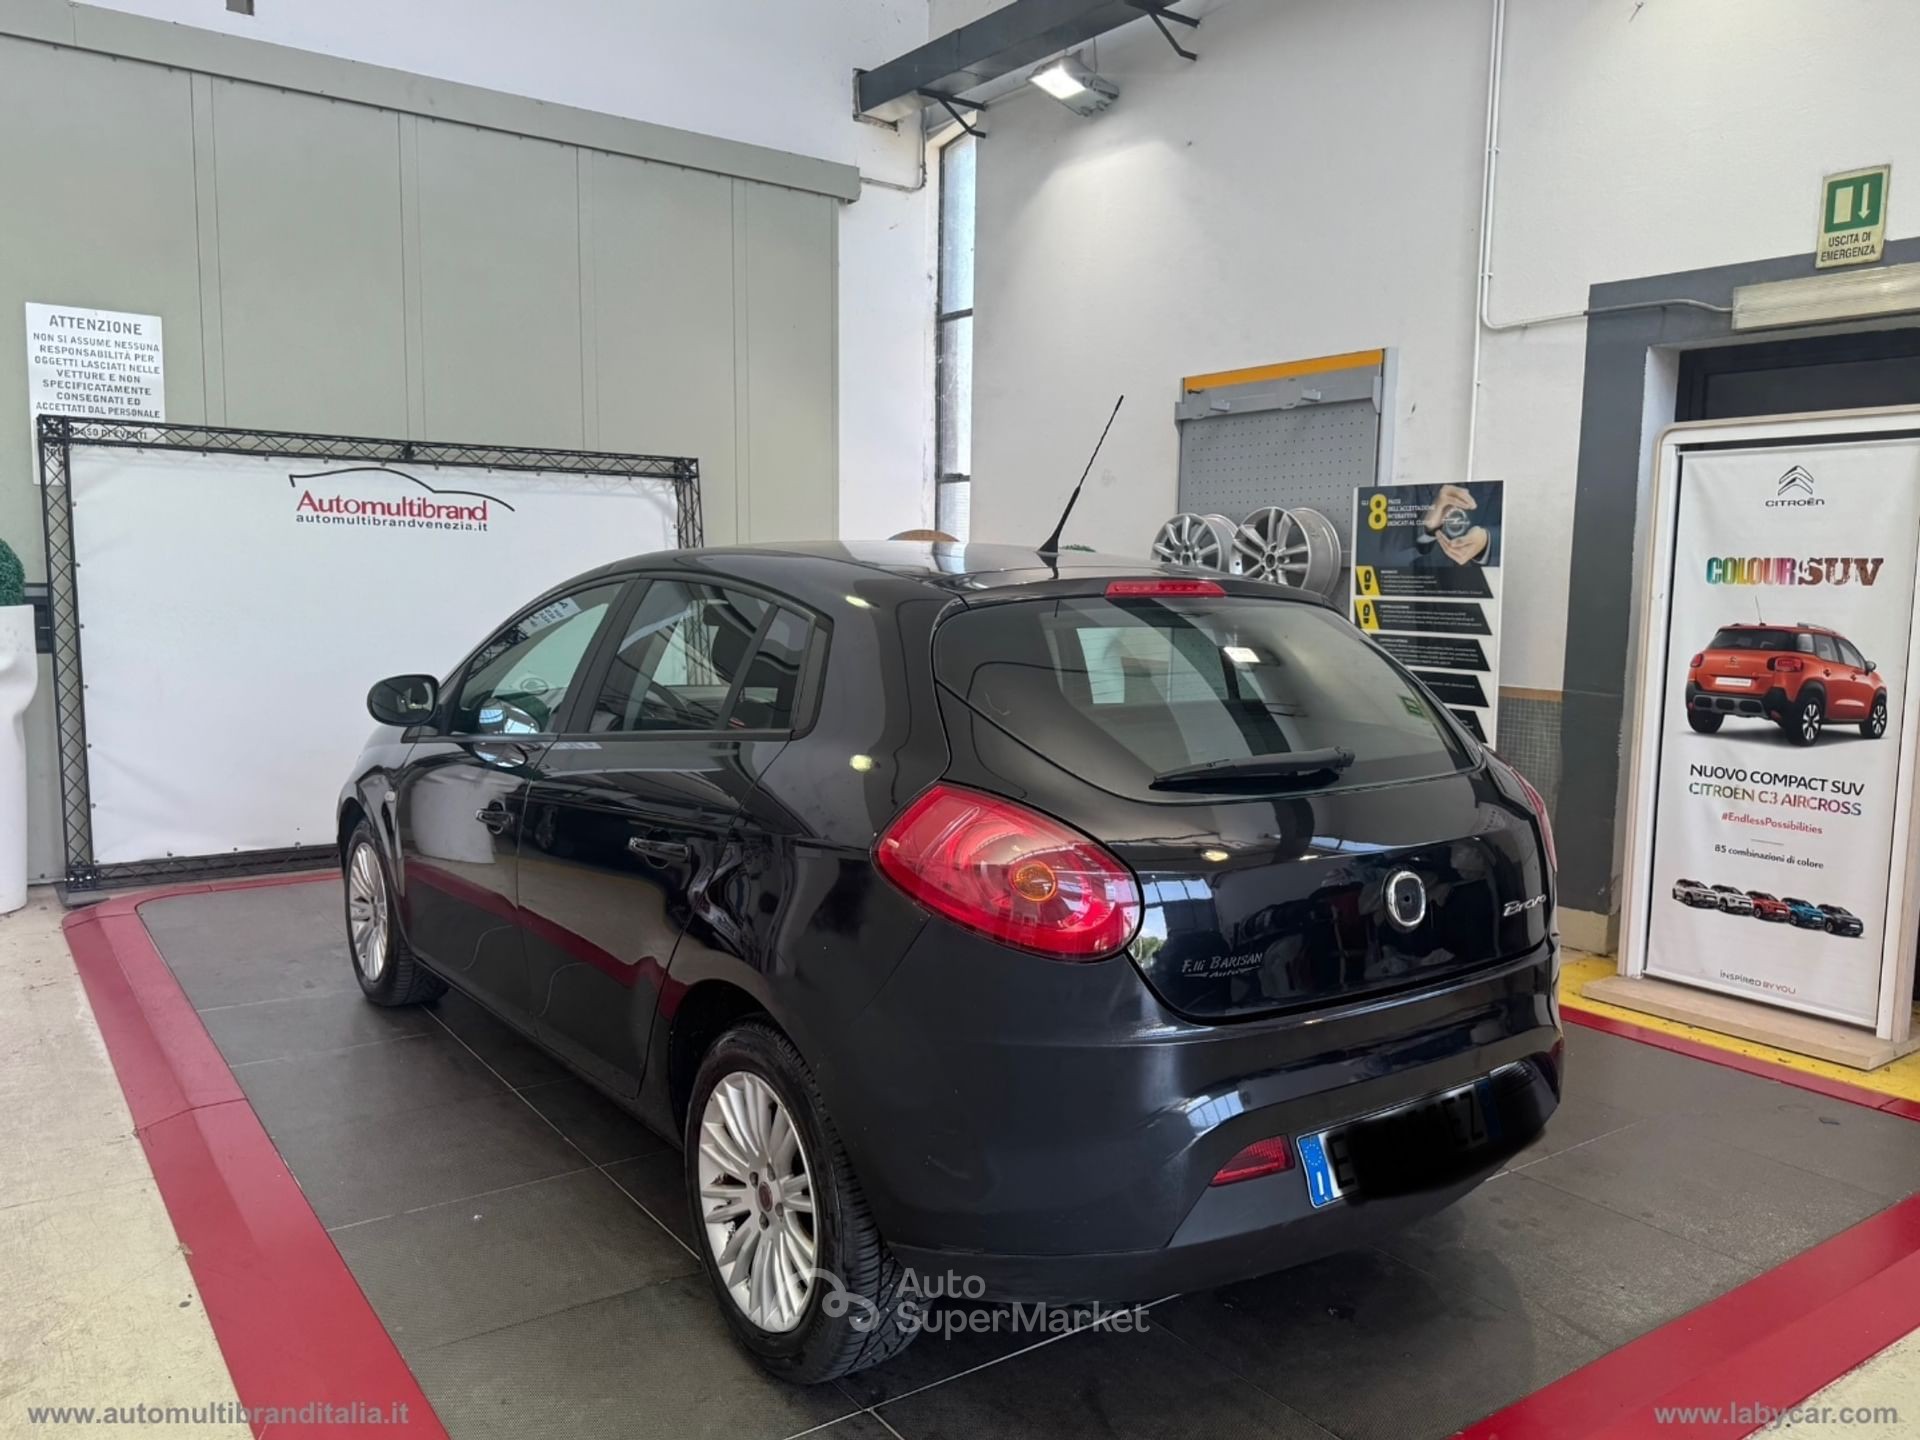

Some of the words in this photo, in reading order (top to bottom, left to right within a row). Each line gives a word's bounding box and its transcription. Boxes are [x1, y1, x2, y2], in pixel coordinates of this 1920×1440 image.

[1828, 233, 1859, 247] USCITA
[1862, 231, 1872, 242] DI
[1821, 244, 1876, 262] EMERGENZA
[49, 314, 142, 335] ATTENZIONE
[33, 332, 54, 342] NON
[57, 334, 67, 343] SI
[70, 335, 111, 348] ASSUME
[114, 340, 160, 352] NESSUNA
[81, 359, 126, 372] LASCIATI
[129, 365, 160, 375] NELLE
[134, 353, 155, 363] PER
[56, 368, 106, 381] VETTURE
[109, 373, 117, 382] E
[119, 374, 141, 384] NON
[43, 379, 152, 396] SPECIFICATAMENTE
[56, 392, 124, 405] CONSEGNATI
[127, 397, 141, 406] ED
[36, 401, 86, 413] ACCETTATI
[88, 405, 106, 415] DAL
[108, 407, 160, 419] PERSONALE
[296, 489, 488, 521] Automultibrand
[1368, 493, 1388, 531] 8
[1765, 498, 1825, 508] CITROËN
[296, 513, 488, 532] automultibrandvenezia.it
[1690, 764, 1747, 783] NUOVO
[1750, 771, 1828, 792] COMPACT
[1830, 780, 1865, 797] SUV
[1758, 790, 1778, 805] C3
[1780, 793, 1862, 817] AIRCROSS
[1721, 812, 1823, 835] #EndlessPossibilities
[1714, 844, 1726, 853] 85
[1728, 848, 1785, 863] combinazioni
[1786, 855, 1795, 864] di
[1797, 858, 1824, 870] colore
[1503, 894, 1547, 917] Bravo
[1209, 952, 1263, 969] BARISAN
[1775, 984, 1796, 995] YOU
